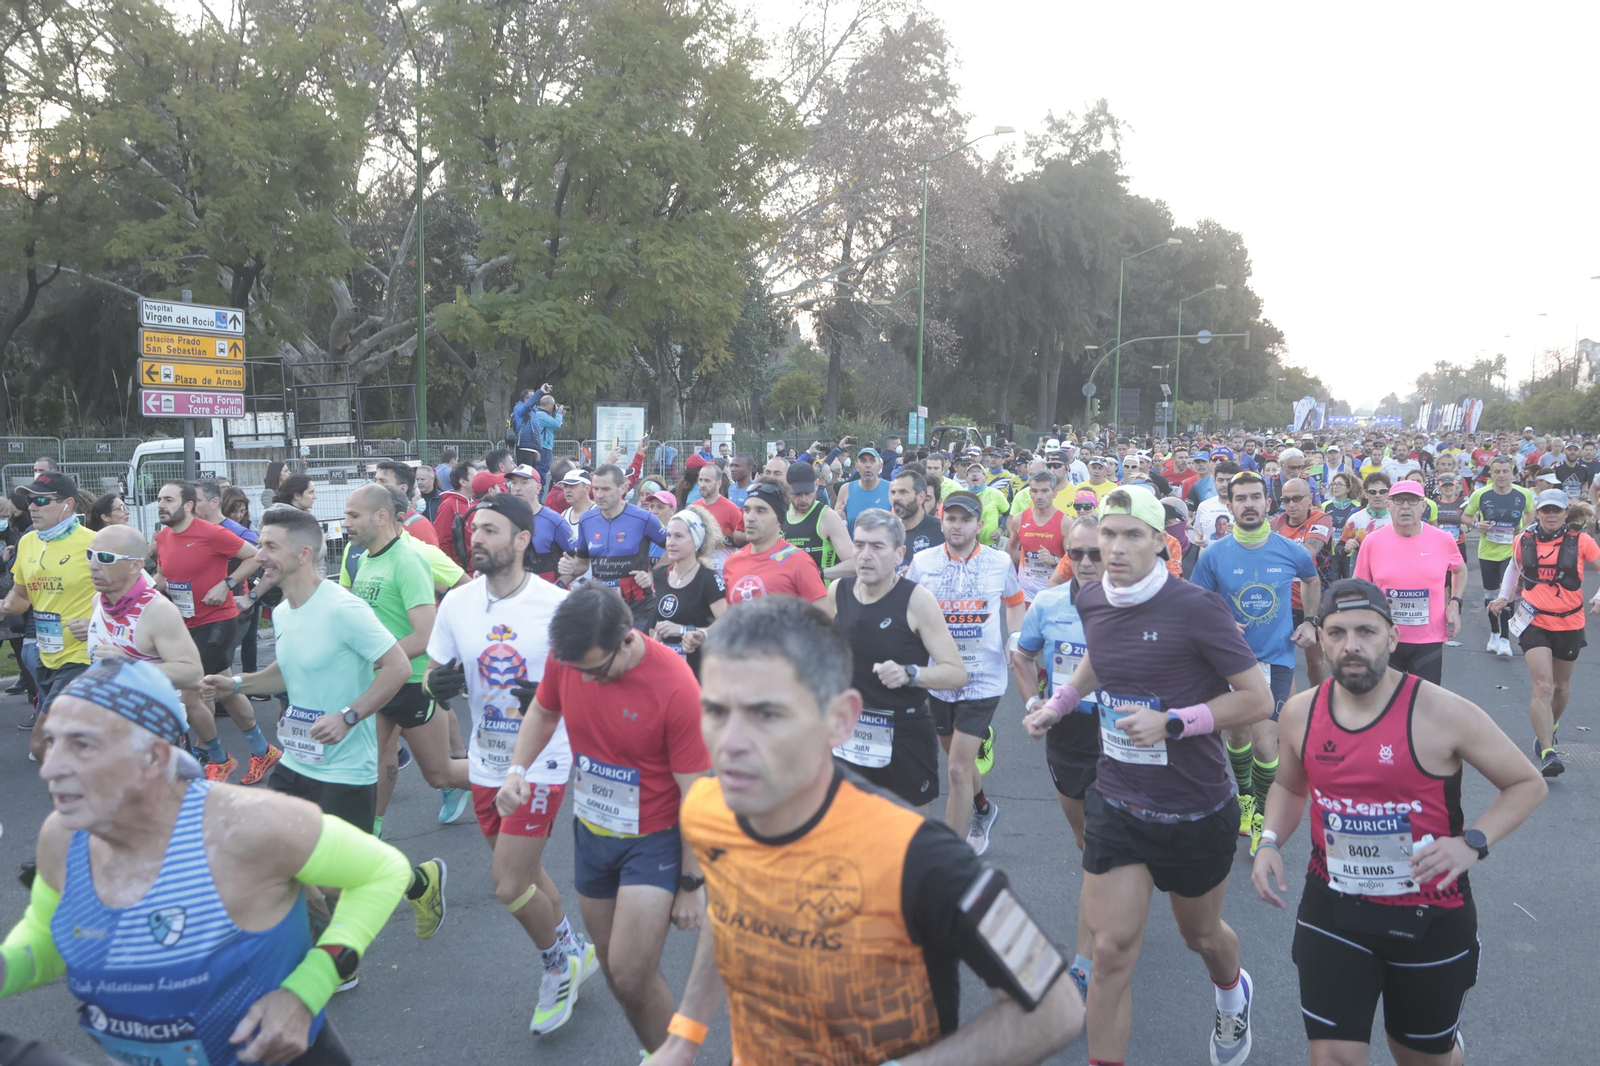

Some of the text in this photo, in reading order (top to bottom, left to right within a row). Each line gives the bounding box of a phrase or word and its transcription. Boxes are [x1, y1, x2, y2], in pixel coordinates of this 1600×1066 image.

[144, 302, 174, 313] hospital
[145, 311, 173, 324] Virgen
[175, 315, 189, 325] del
[145, 335, 201, 346] estación Prado
[145, 343, 207, 356] San Sebastián
[215, 367, 242, 376] estación
[174, 374, 242, 387] Plaza de Armas
[189, 394, 242, 405] Caixa Forum
[188, 404, 242, 415] Torre Sevilla
[200, 471, 214, 479] AMS
[332, 470, 344, 478] AMS
[1233, 567, 1244, 576] edp
[27, 582, 64, 591] SEVILLA
[1250, 593, 1263, 601] edp
[943, 600, 978, 610] ROTA
[291, 708, 319, 721] ZURICH
[858, 714, 888, 725] URICH
[291, 726, 307, 738] 9741
[853, 729, 873, 741] 8029
[487, 739, 507, 750] 9746
[853, 743, 870, 753] JUAN
[591, 762, 632, 782] ZURICH
[591, 783, 614, 799] 8207
[586, 797, 620, 816] GONZALO
[1344, 818, 1399, 832] ZURICH
[1348, 844, 1381, 858] 8402
[1342, 863, 1395, 876] ALE RIVAS
[95, 980, 155, 995] Atletismo
[157, 971, 211, 991] Linense
[108, 1017, 180, 1039] ZURICH
